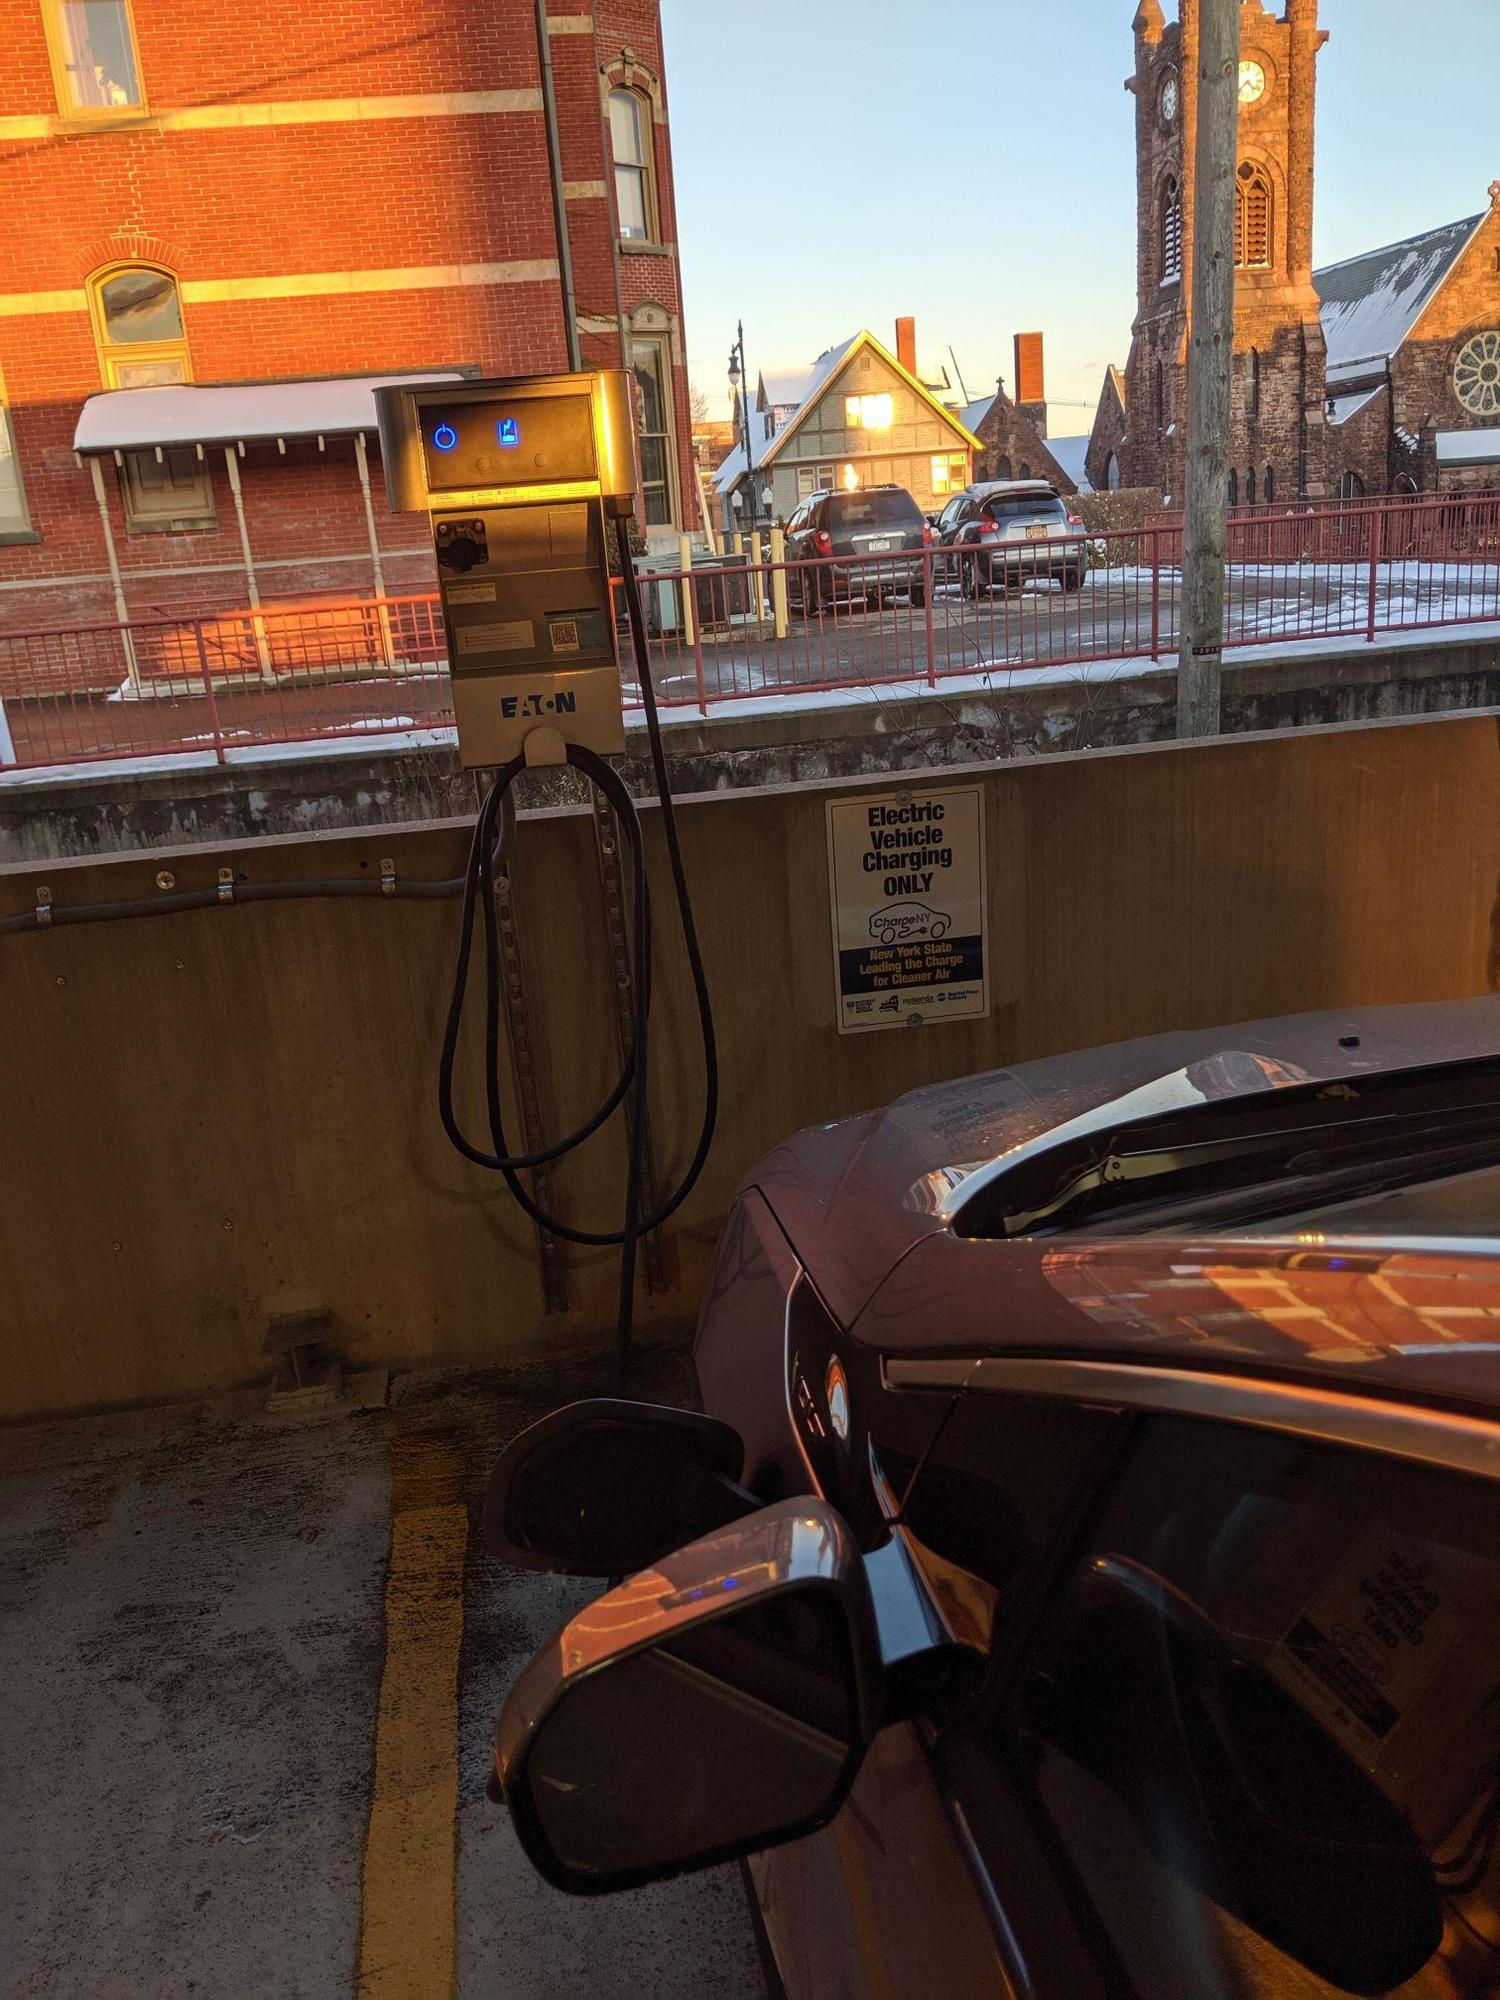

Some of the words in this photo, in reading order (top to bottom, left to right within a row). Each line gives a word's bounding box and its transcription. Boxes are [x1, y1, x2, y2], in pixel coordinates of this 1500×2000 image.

[500, 691, 576, 718] EATON
[868, 801, 945, 827] Electric
[870, 825, 943, 850] Vehicle
[862, 847, 952, 872] Charging
[884, 872, 934, 896] ONLY
[873, 912, 932, 930] ChargeNY
[869, 949, 894, 961] New
[896, 945, 921, 957] York
[923, 942, 952, 955] State
[859, 961, 900, 975] Leading
[905, 958, 922, 969] the
[925, 954, 963, 968] Charge
[873, 975, 888, 987] for
[891, 971, 932, 984] Cleaner
[935, 969, 951, 980] Air
